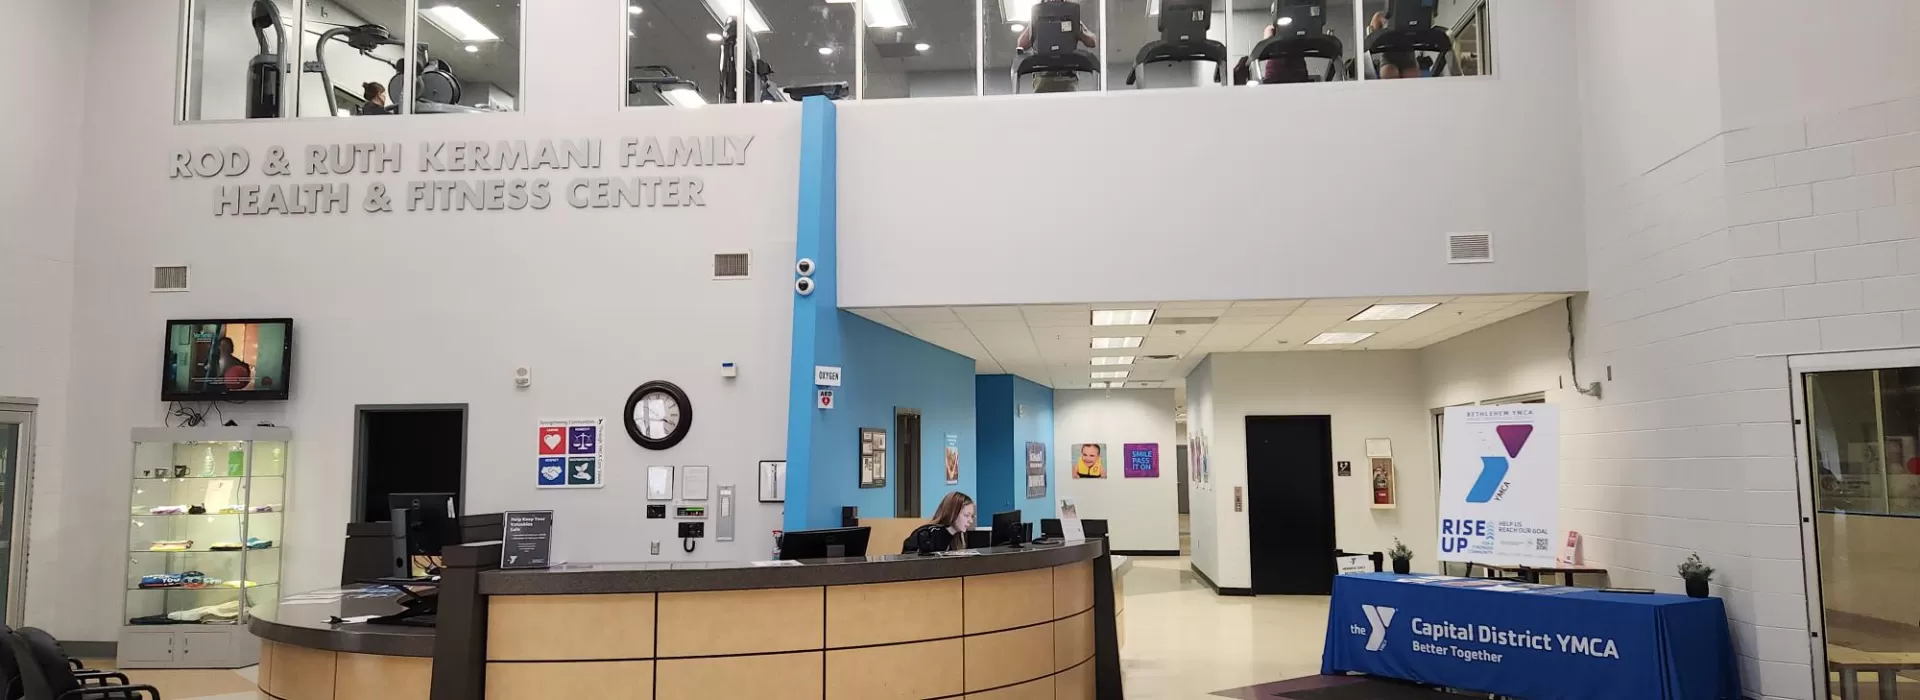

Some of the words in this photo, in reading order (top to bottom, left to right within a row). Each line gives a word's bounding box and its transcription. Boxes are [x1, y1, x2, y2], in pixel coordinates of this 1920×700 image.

[169, 146, 250, 178] ROD
[261, 145, 291, 176] &
[304, 142, 402, 175] RUTH
[418, 137, 602, 173] KERMANI
[619, 135, 756, 168] FAMILY
[213, 182, 350, 217] HEALTH
[362, 181, 393, 214] &
[406, 177, 551, 212] FITNESS
[566, 175, 707, 209] CENTER
[818, 370, 840, 381] OXYGEN
[1131, 450, 1152, 458] SMILE
[1494, 481, 1511, 502] YMCA
[1442, 519, 1486, 537] RISE
[1441, 536, 1468, 553] UP
[1350, 624, 1367, 636] the
[1411, 617, 1474, 641] Capital
[1478, 625, 1552, 651] District
[1556, 633, 1620, 660] YMCA
[1412, 641, 1448, 656] Better
[1449, 645, 1504, 663] Together
